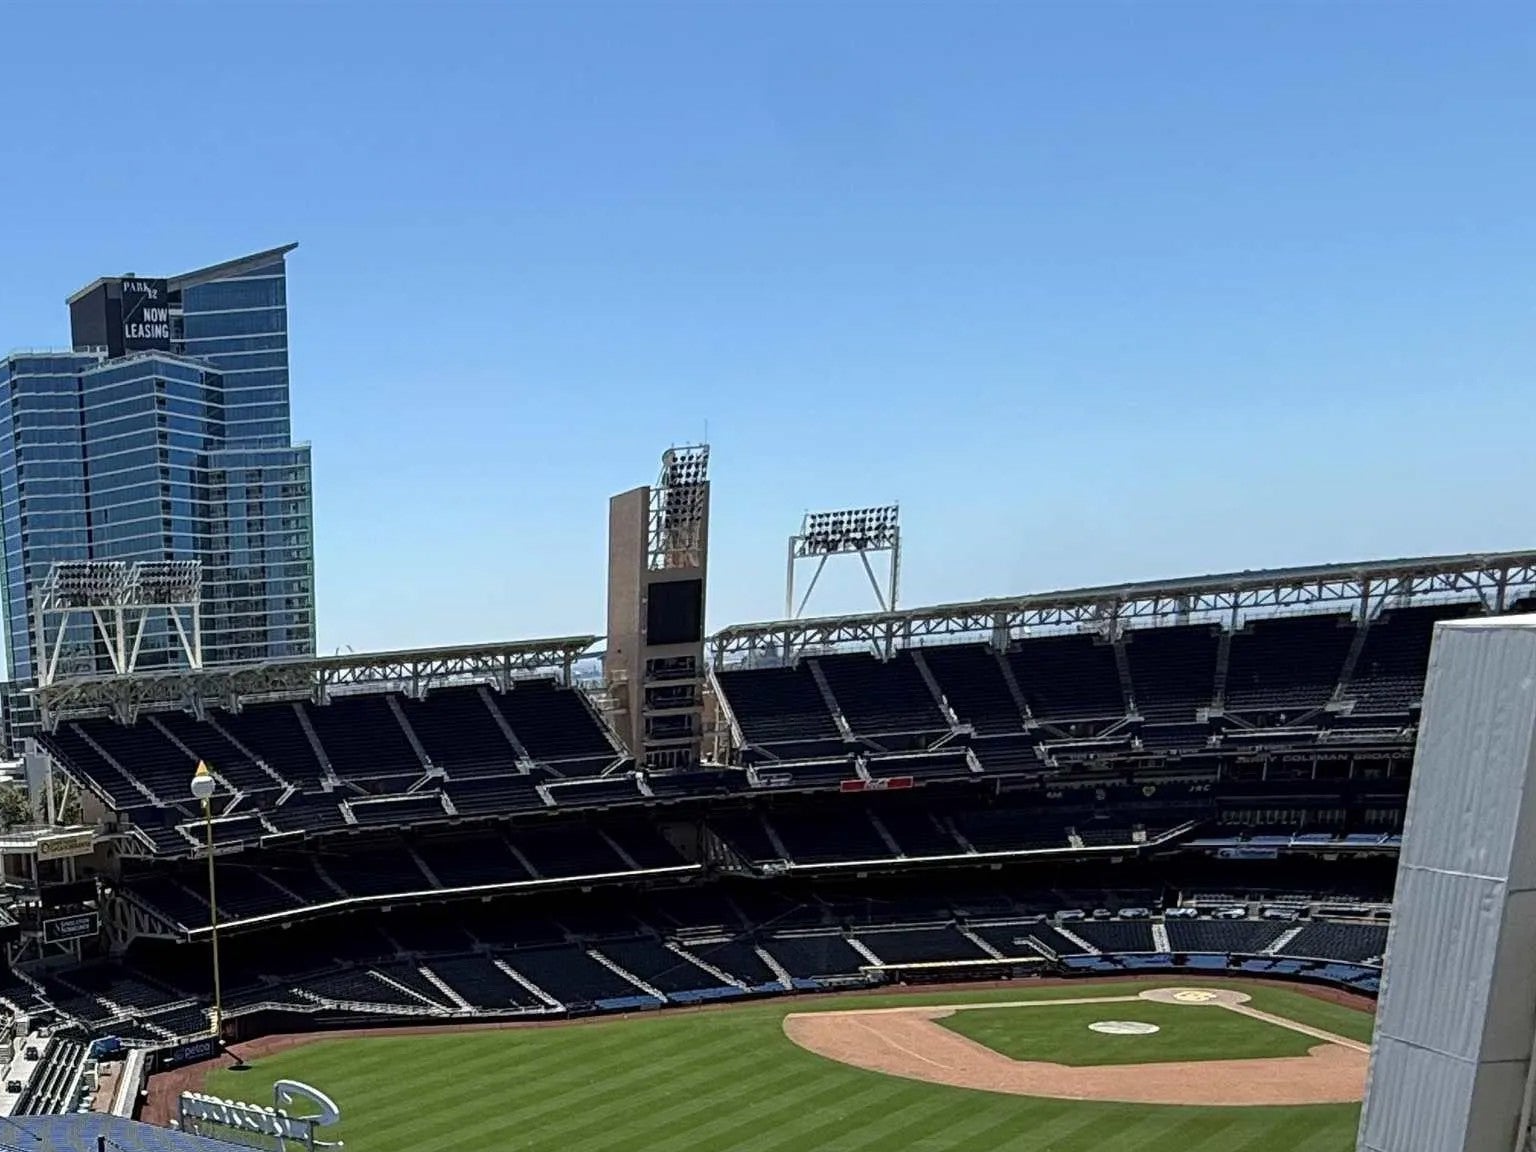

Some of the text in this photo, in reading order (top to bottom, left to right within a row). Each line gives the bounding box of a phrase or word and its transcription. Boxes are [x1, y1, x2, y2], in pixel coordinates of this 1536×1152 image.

[124, 281, 151, 293] PARK
[144, 307, 169, 322] NOW
[125, 323, 169, 339] LEASING
